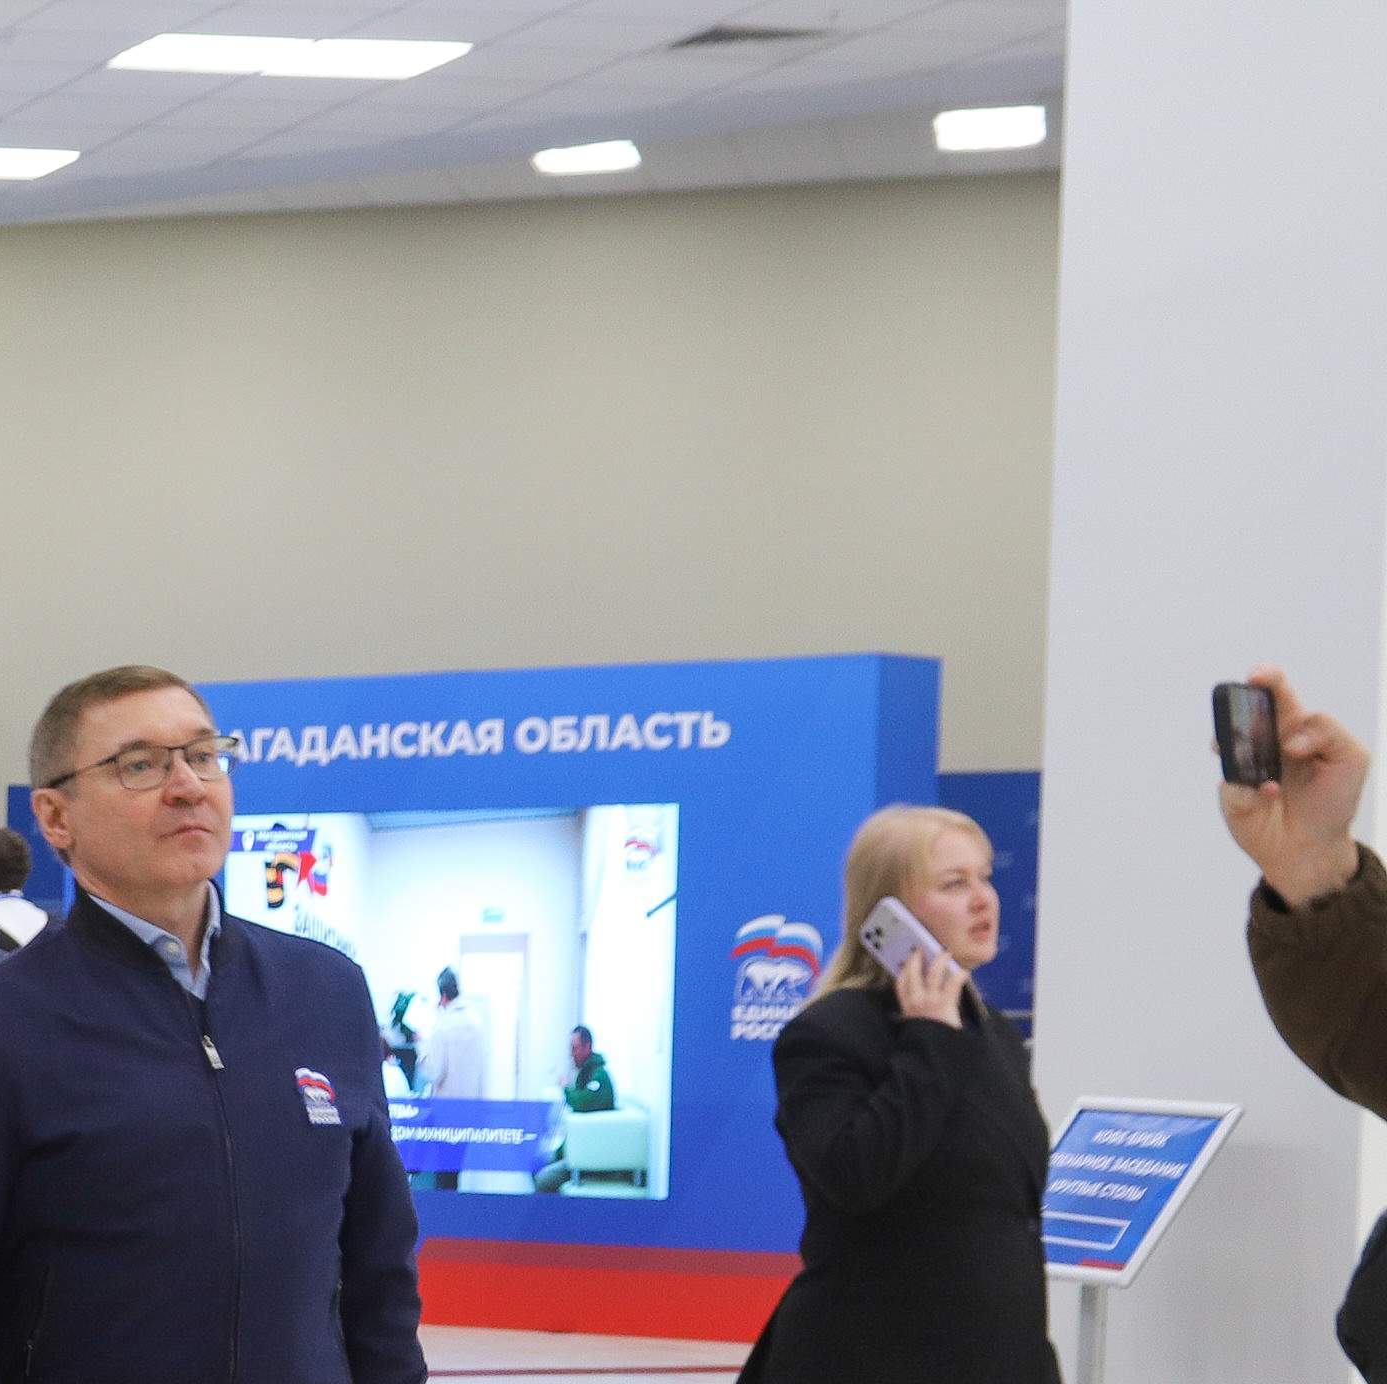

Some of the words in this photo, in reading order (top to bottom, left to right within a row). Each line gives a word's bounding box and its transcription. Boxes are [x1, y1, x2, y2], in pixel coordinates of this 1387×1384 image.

[226, 717, 504, 767] АГАДАНСКАЯ
[514, 712, 731, 755] ОБЛАСТЬ
[731, 1005, 801, 1021] ЕДИН
[730, 1022, 784, 1040] РОСС
